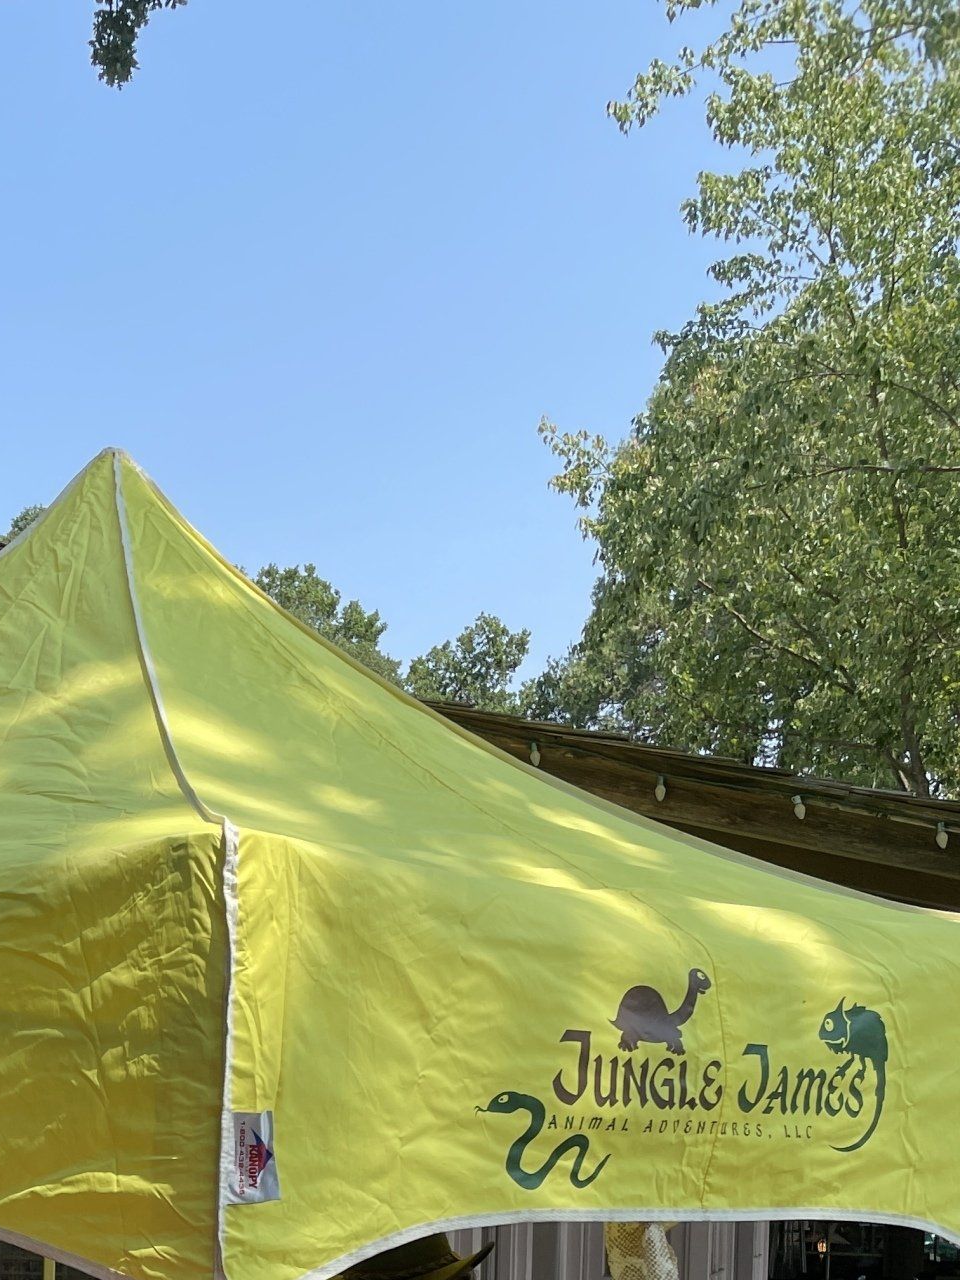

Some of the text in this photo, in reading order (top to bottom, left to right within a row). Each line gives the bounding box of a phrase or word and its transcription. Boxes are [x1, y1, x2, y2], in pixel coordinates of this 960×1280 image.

[551, 1029, 865, 1119] JUNGLE JAMES
[547, 1114, 814, 1139] ANIMAL ADVENTURES, LLC
[249, 1144, 259, 1189] KANOPY
